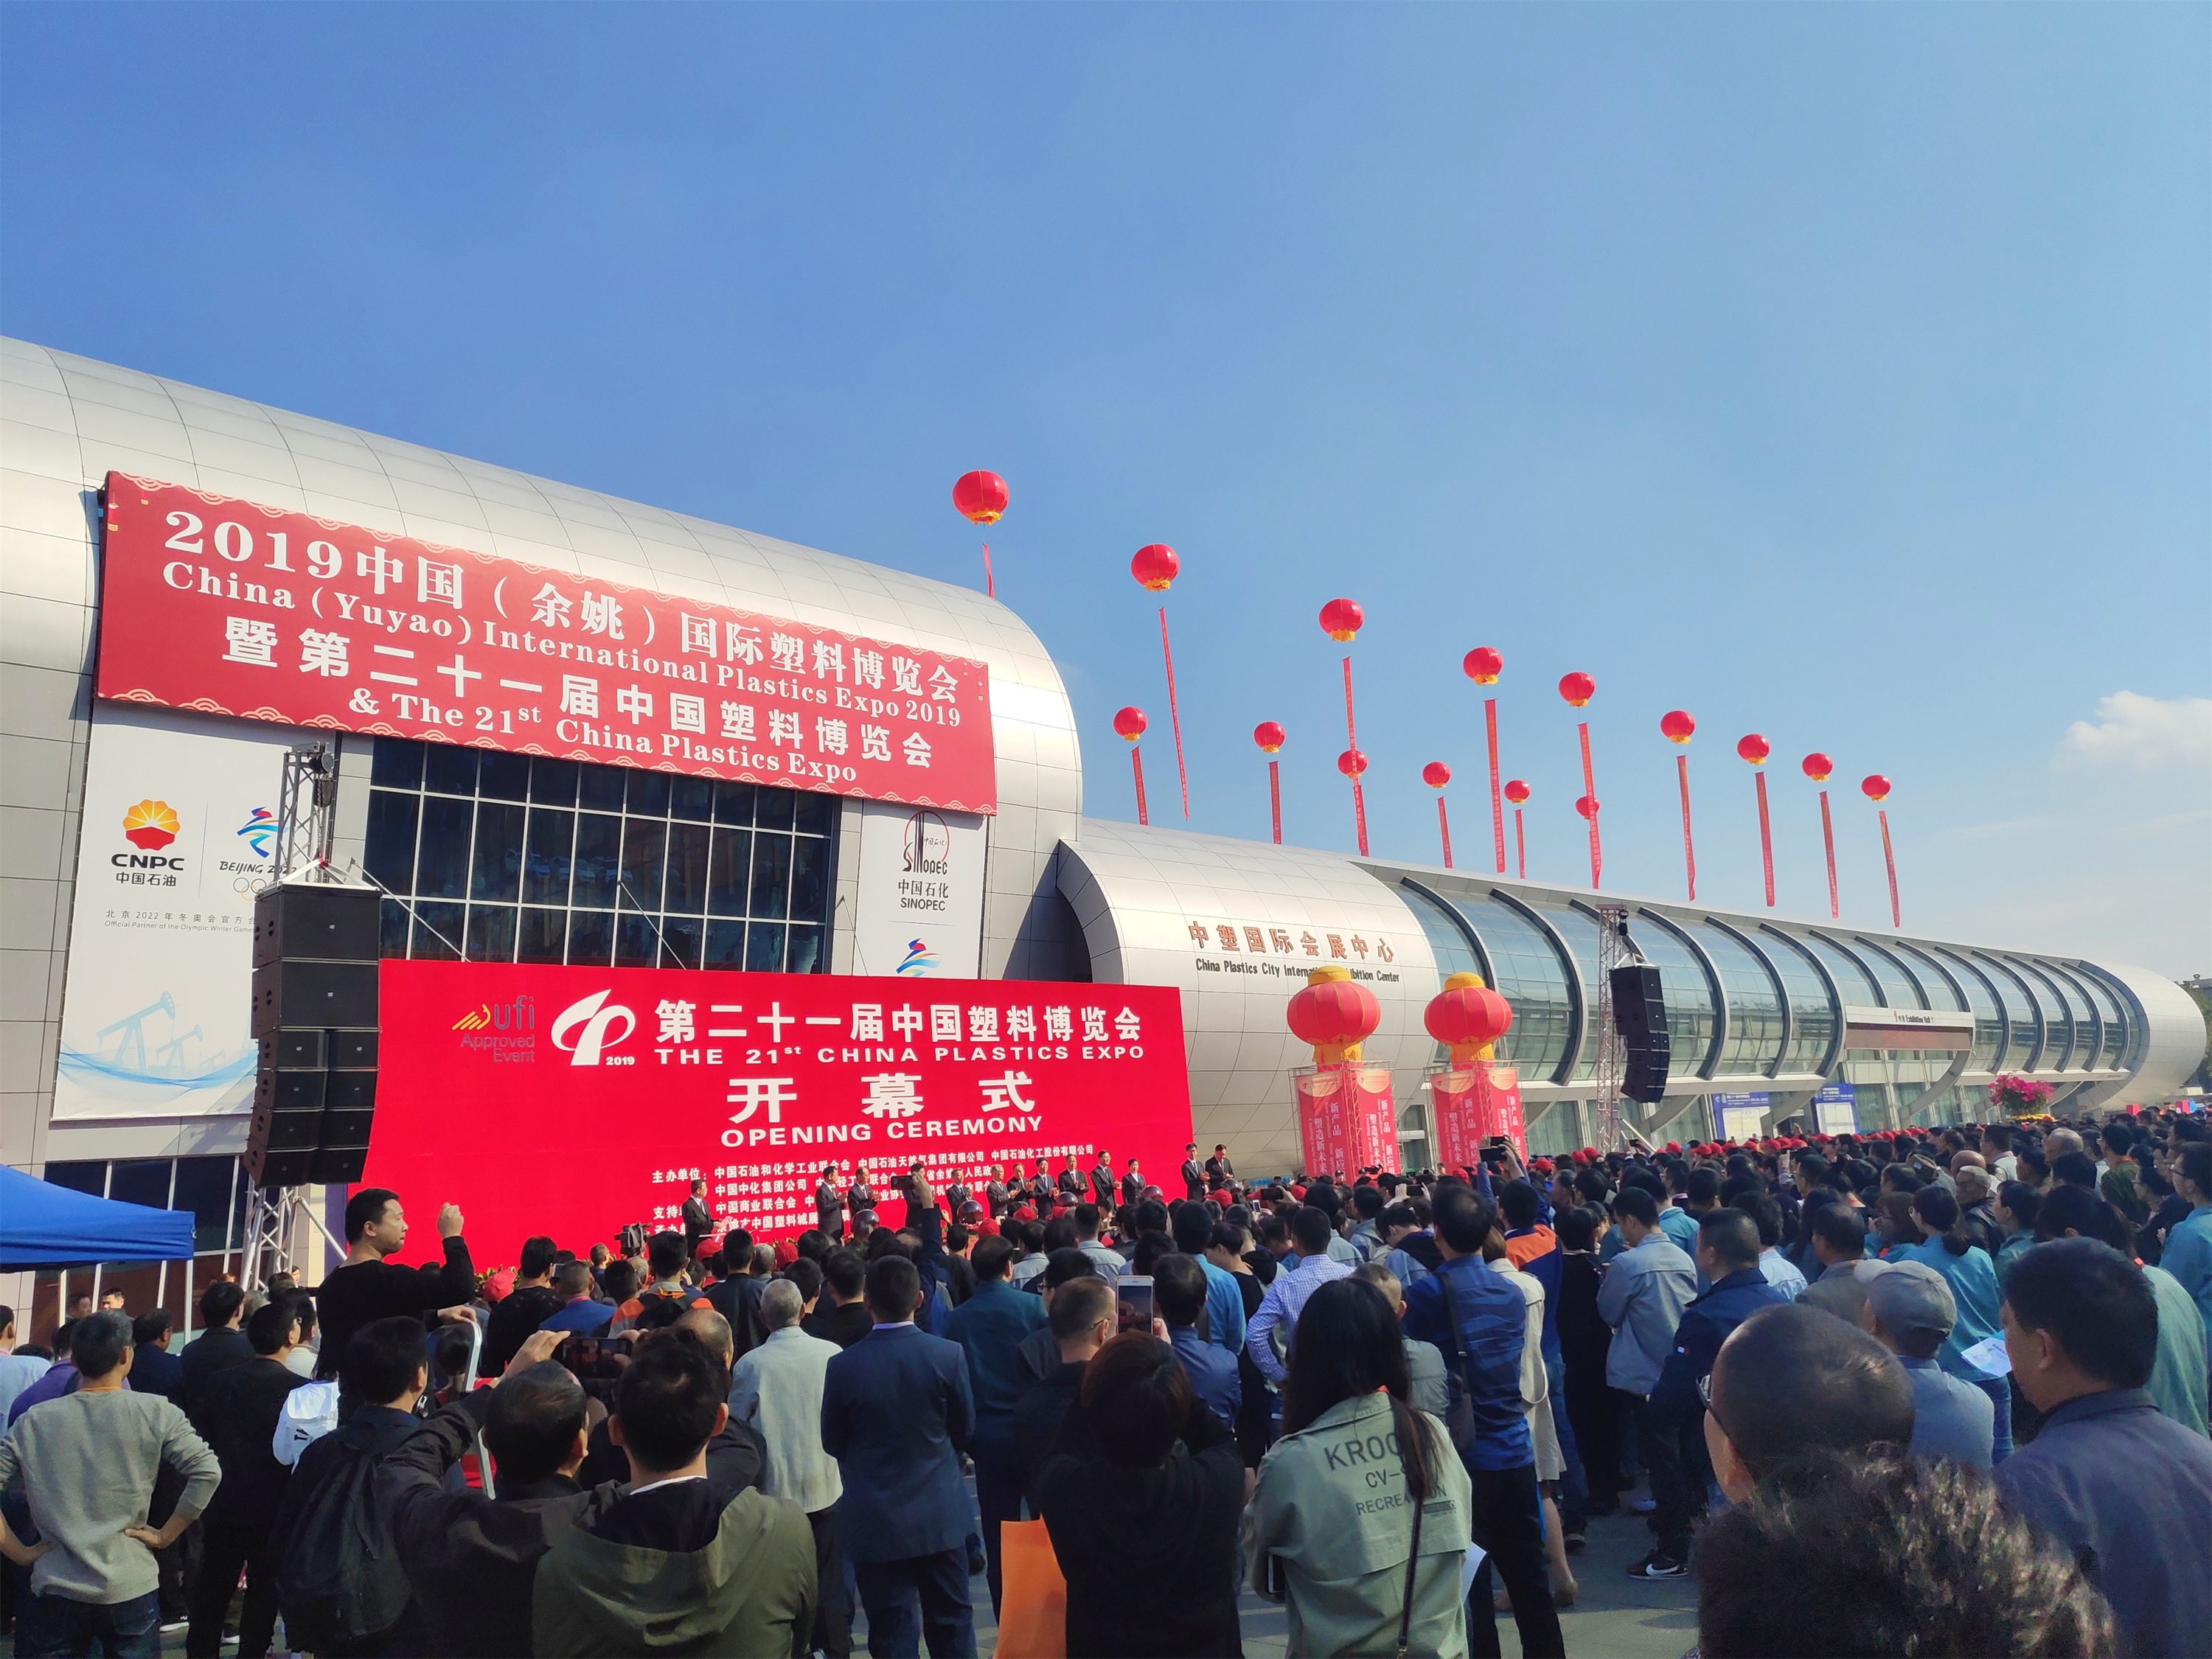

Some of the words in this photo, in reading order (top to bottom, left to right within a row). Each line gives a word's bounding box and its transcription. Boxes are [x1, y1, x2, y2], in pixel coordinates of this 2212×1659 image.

[162, 561, 296, 610] China
[484, 620, 708, 683] International
[717, 663, 828, 704] Plastics
[835, 689, 900, 722] Expo
[905, 700, 961, 728] 2019
[221, 615, 933, 769] 暨第二十一届中国塑料博览会
[349, 687, 380, 715] &
[392, 694, 464, 727] The
[475, 705, 542, 735] 21st
[555, 719, 653, 754] China
[661, 733, 780, 772] Plastics
[787, 751, 857, 785] Expo
[111, 854, 185, 871] CNPC
[219, 861, 263, 874] BEIJING
[116, 872, 177, 887] 中国石油
[898, 878, 949, 899] 中国石化
[900, 897, 946, 911] SINOPEC
[104, 919, 131, 928] Official
[180, 923, 209, 932] Olympic
[234, 925, 254, 933] Game
[1189, 921, 1395, 963] 中塑国际会展中心
[1195, 958, 1221, 973] China
[1224, 960, 1258, 975] Plastics
[1262, 963, 1281, 978] City
[1377, 970, 1400, 983] Center
[494, 995, 535, 1030] ufi
[654, 998, 1141, 1044] 第二十一届中国塑料博览会
[460, 1034, 535, 1052] Approved
[493, 1049, 535, 1063] Event
[605, 1055, 636, 1066] 2019
[654, 1048, 723, 1065] THE
[745, 1045, 802, 1065] 21st
[817, 1047, 919, 1063] CHINA
[935, 1046, 1069, 1062] PLASTICS
[1082, 1045, 1144, 1060] EXPO
[1330, 1102, 1342, 1136] 新产品
[720, 1124, 872, 1148] OPENING
[887, 1115, 1043, 1140] CEREMONY
[991, 1144, 1093, 1162] 中国石油化工股份有限公司
[1314, 1117, 1327, 1174] 塑造新未来
[714, 1178, 807, 1197] 中国中化集团公司
[716, 1196, 796, 1215] 中国商业联合会
[1366, 1467, 1407, 1488] CV-
